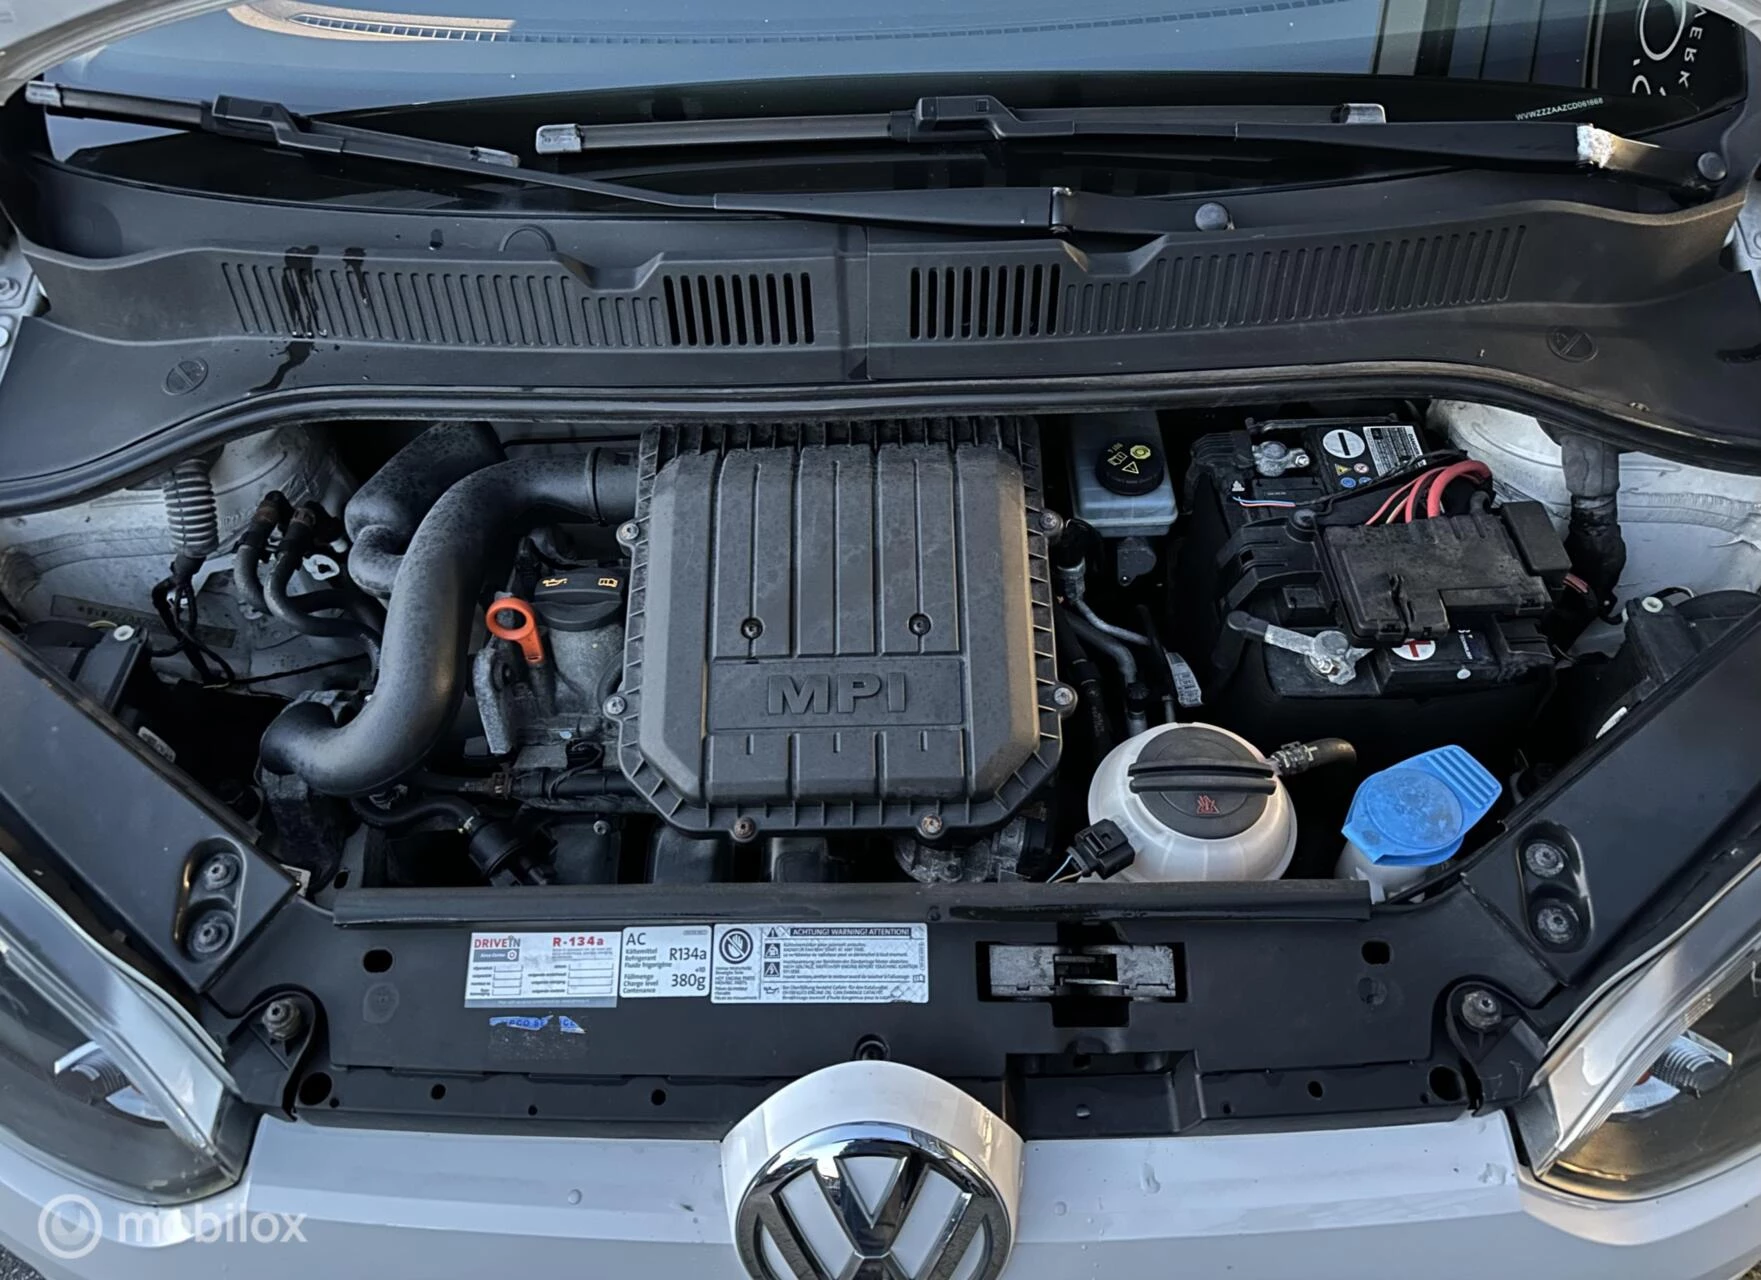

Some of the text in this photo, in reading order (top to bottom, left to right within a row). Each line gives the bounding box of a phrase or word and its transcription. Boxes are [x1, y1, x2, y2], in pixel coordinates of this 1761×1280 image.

[767, 672, 906, 716] MPI
[625, 932, 646, 946] AC
[792, 928, 910, 936] ACHTUNG! WARNING! ATTENTION!
[669, 947, 707, 961] R134a
[671, 973, 706, 991] 380g
